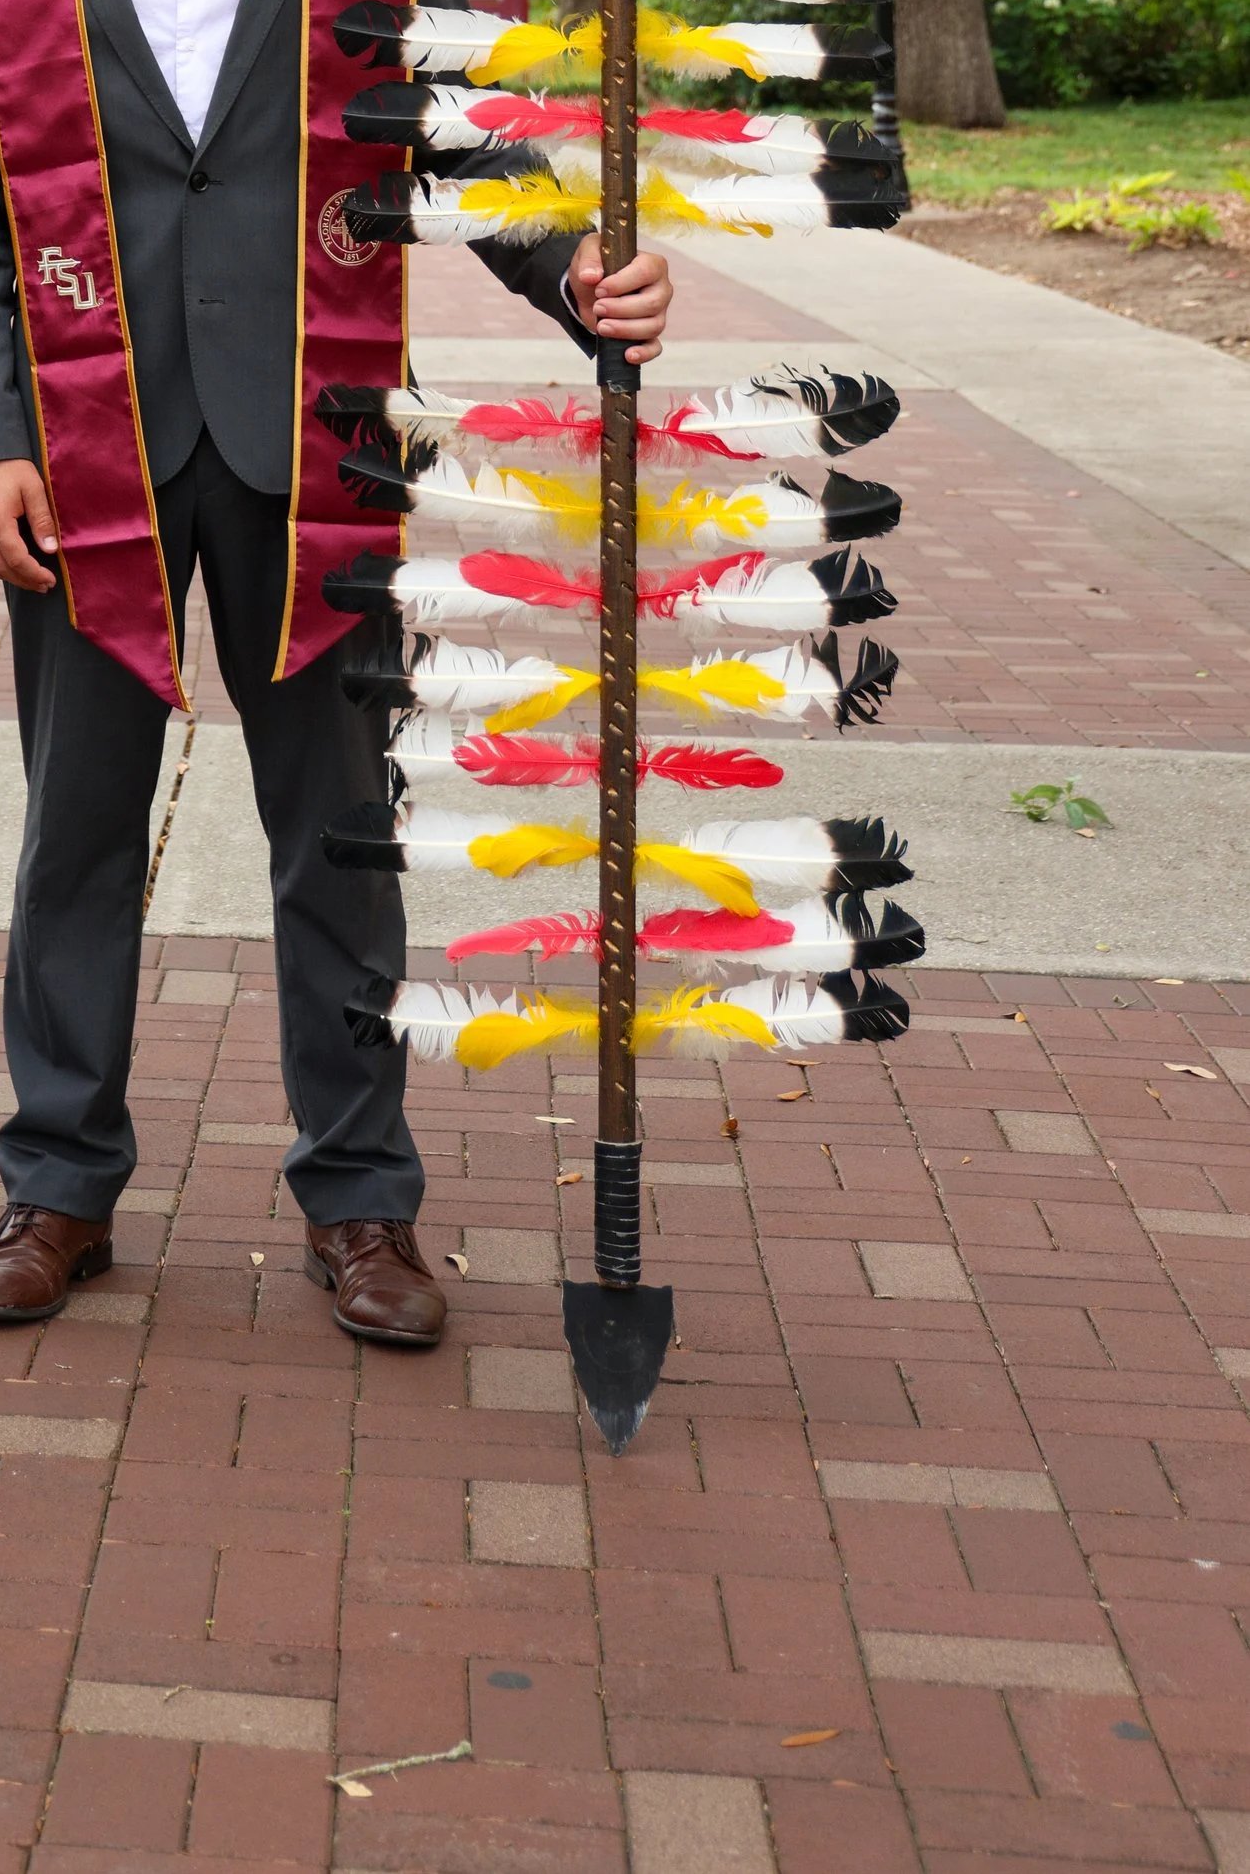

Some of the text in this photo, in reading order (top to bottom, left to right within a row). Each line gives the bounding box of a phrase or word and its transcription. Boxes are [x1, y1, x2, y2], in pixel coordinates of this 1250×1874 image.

[322, 206, 336, 247] FLORIDA
[37, 246, 100, 310] FSU
[343, 253, 360, 262] 1851
